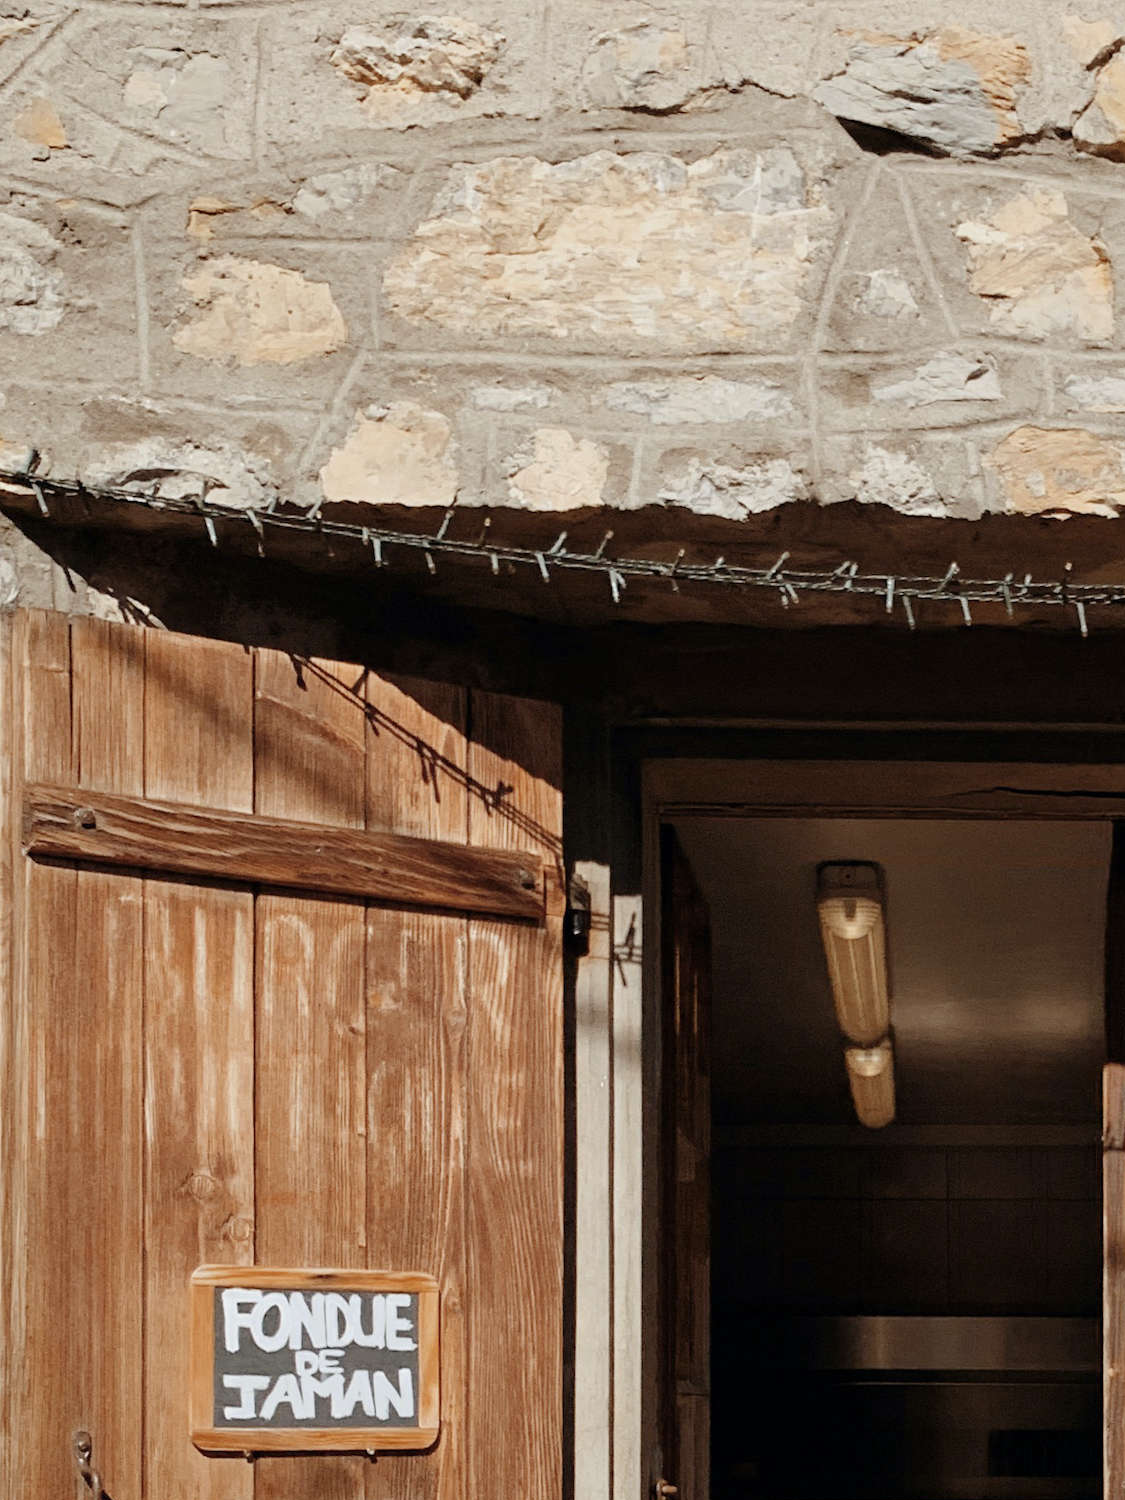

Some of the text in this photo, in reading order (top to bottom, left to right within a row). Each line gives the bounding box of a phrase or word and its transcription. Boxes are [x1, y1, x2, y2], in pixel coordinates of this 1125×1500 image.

[221, 1288, 418, 1353] FONDUE
[295, 1349, 346, 1377] DE
[222, 1367, 415, 1421] JAMAN
